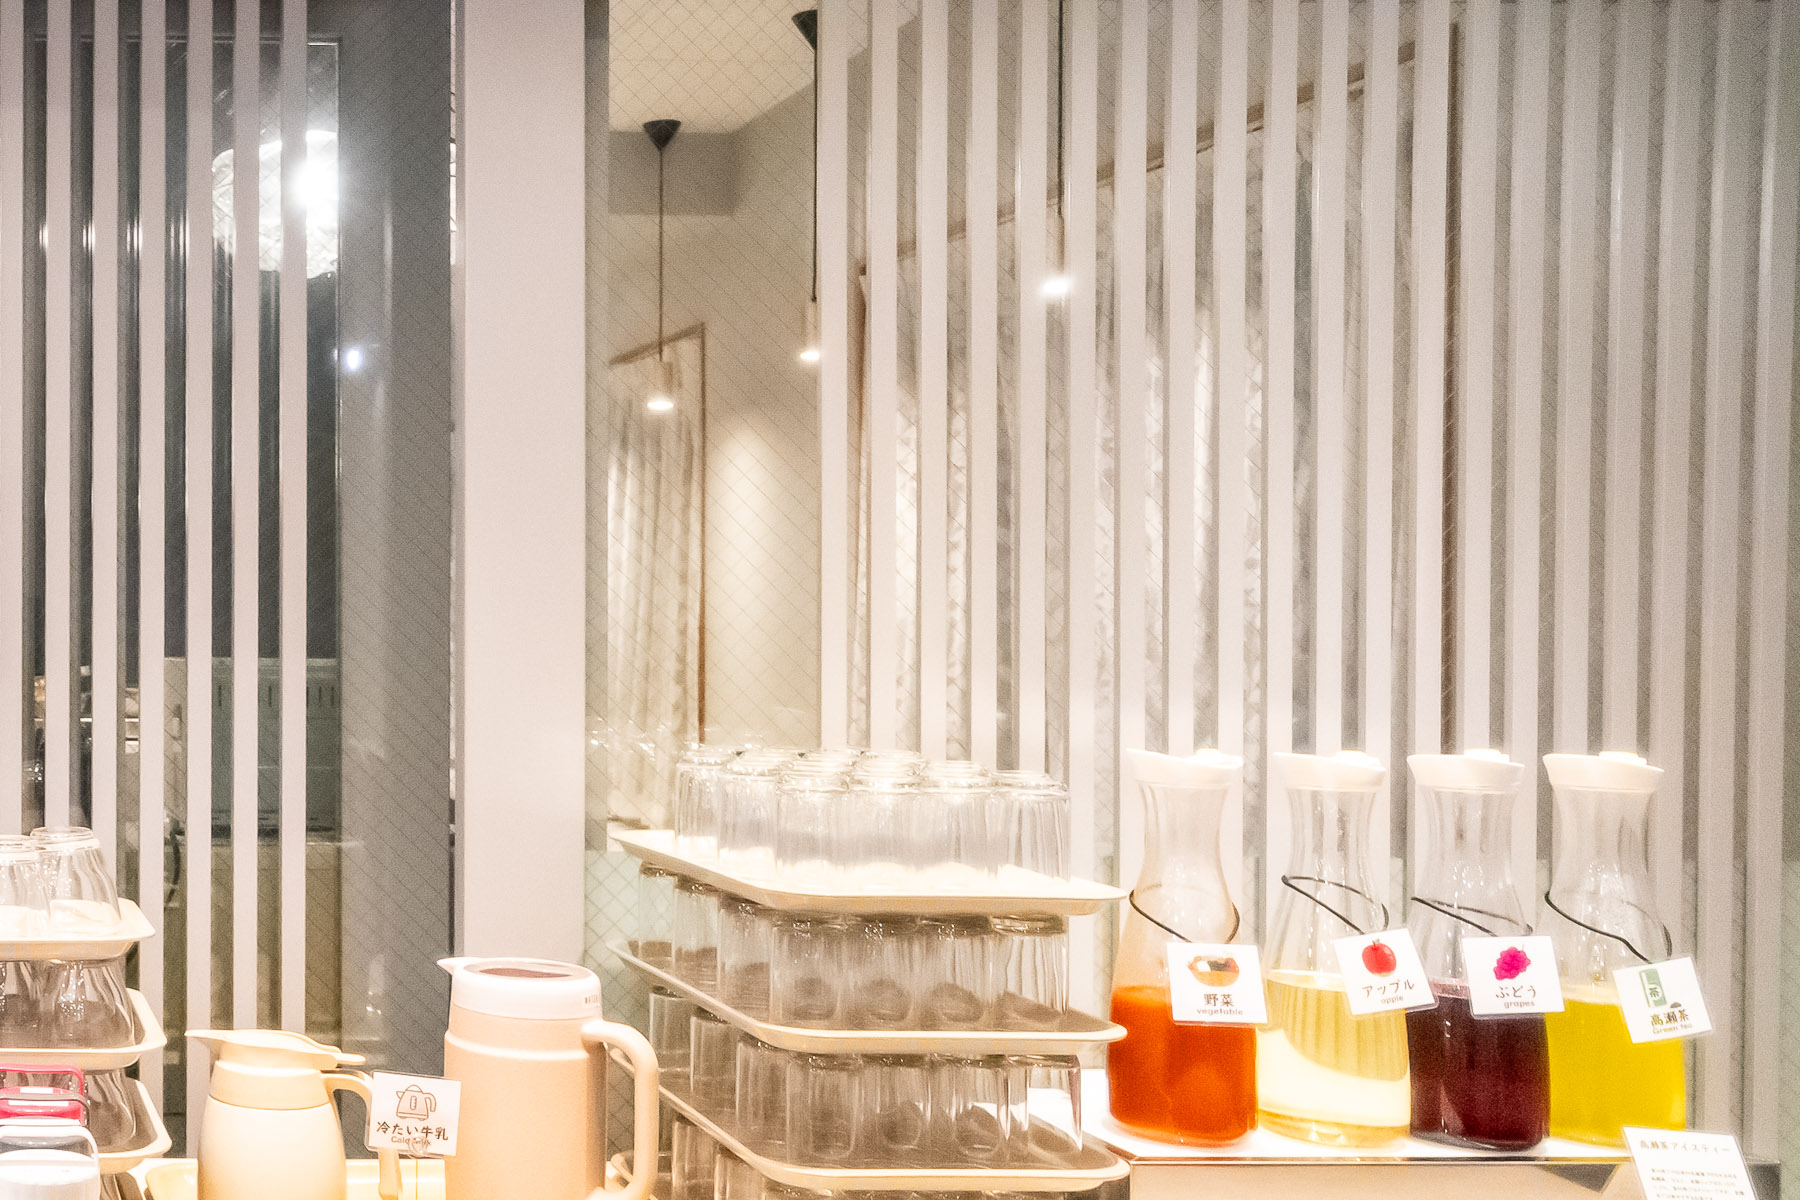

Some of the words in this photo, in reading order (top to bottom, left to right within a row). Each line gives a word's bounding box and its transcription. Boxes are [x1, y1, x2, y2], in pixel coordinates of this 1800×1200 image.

[1361, 979, 1415, 998] アップル
[1495, 985, 1537, 999] ぶどう
[1203, 993, 1235, 1008] 野菜
[1380, 995, 1404, 1005] apple
[1503, 1000, 1536, 1010] grapes
[1196, 1007, 1244, 1017] vegetable
[376, 1120, 449, 1141] 冷たい牛乳
